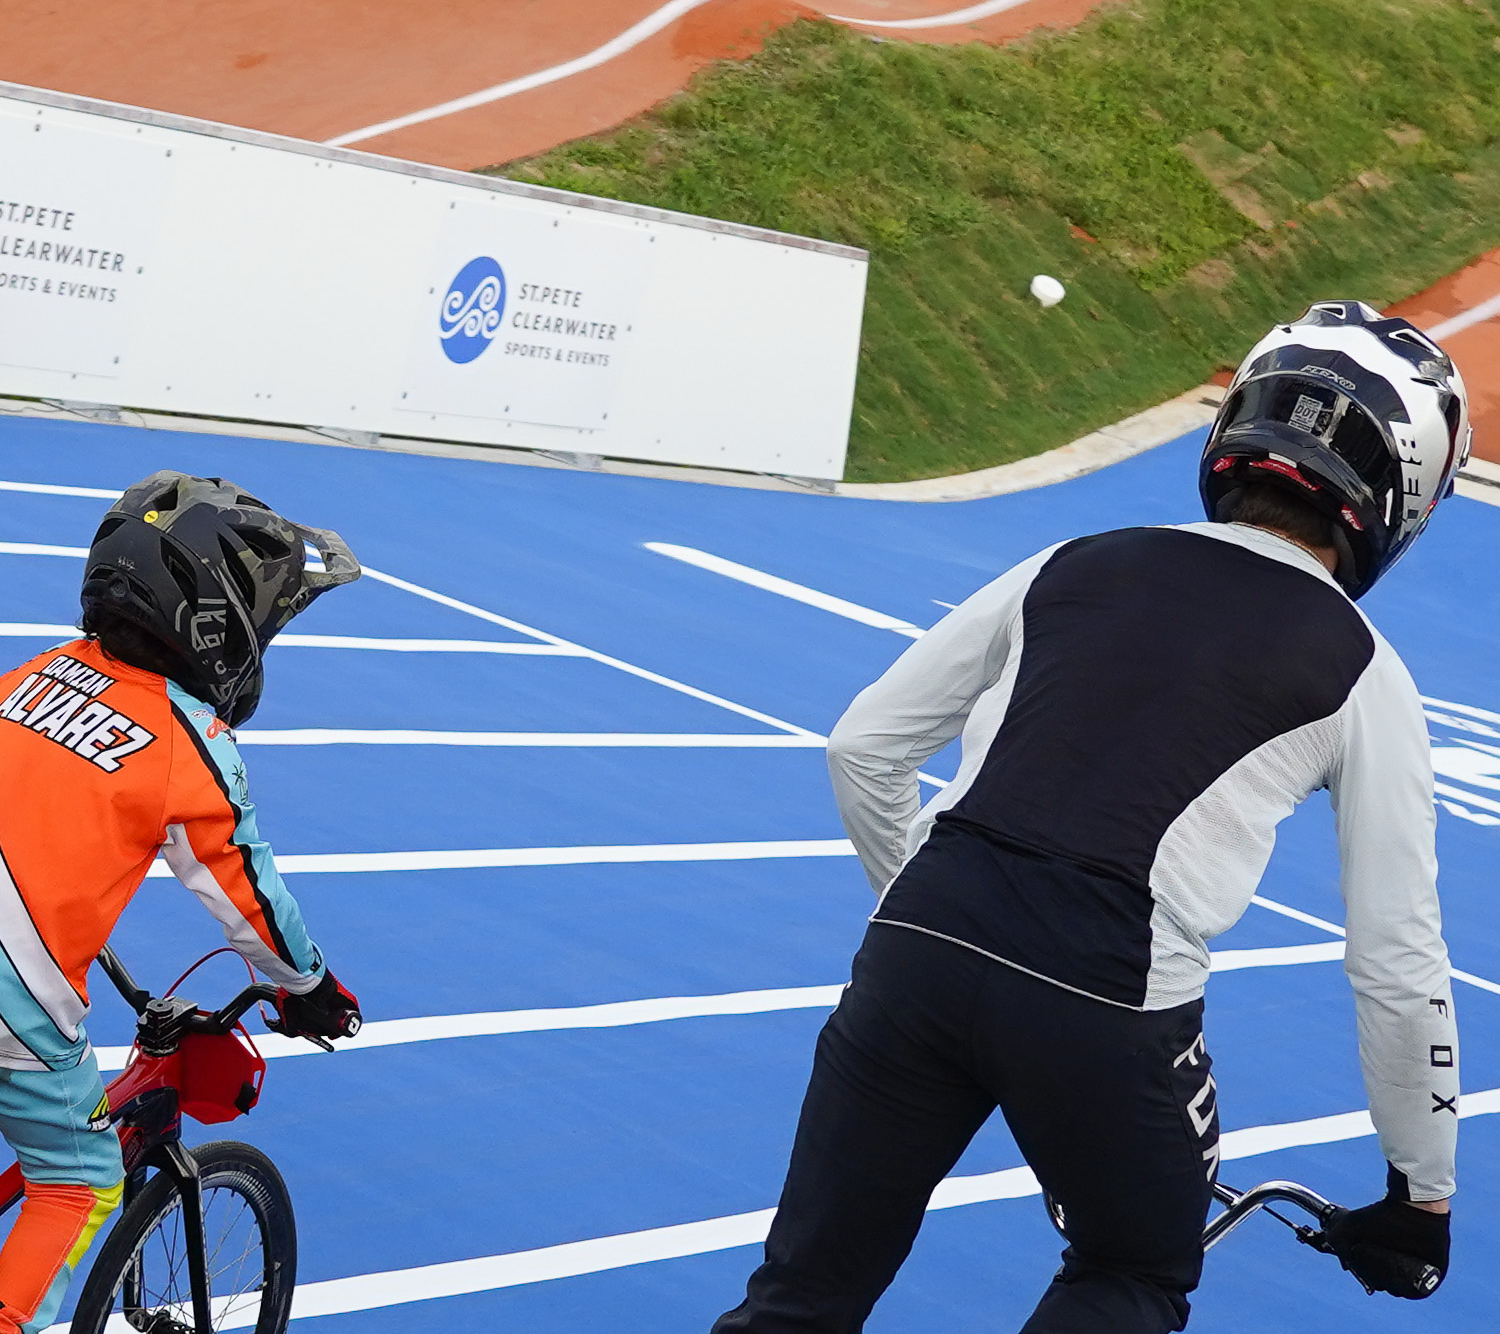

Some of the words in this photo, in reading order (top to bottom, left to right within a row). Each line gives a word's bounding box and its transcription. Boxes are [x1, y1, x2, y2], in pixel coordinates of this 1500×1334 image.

[43, 278, 53, 297] &
[57, 279, 118, 306] EVENTS
[518, 282, 583, 309] ST.PETE
[511, 310, 618, 343] CLEARWATER
[504, 341, 551, 363] SPORTS
[554, 348, 564, 364] &
[565, 347, 612, 369] EVENTS
[1294, 404, 1319, 422] DOT
[41, 653, 115, 696] DAMIAN
[1429, 998, 1458, 1116] FOX
